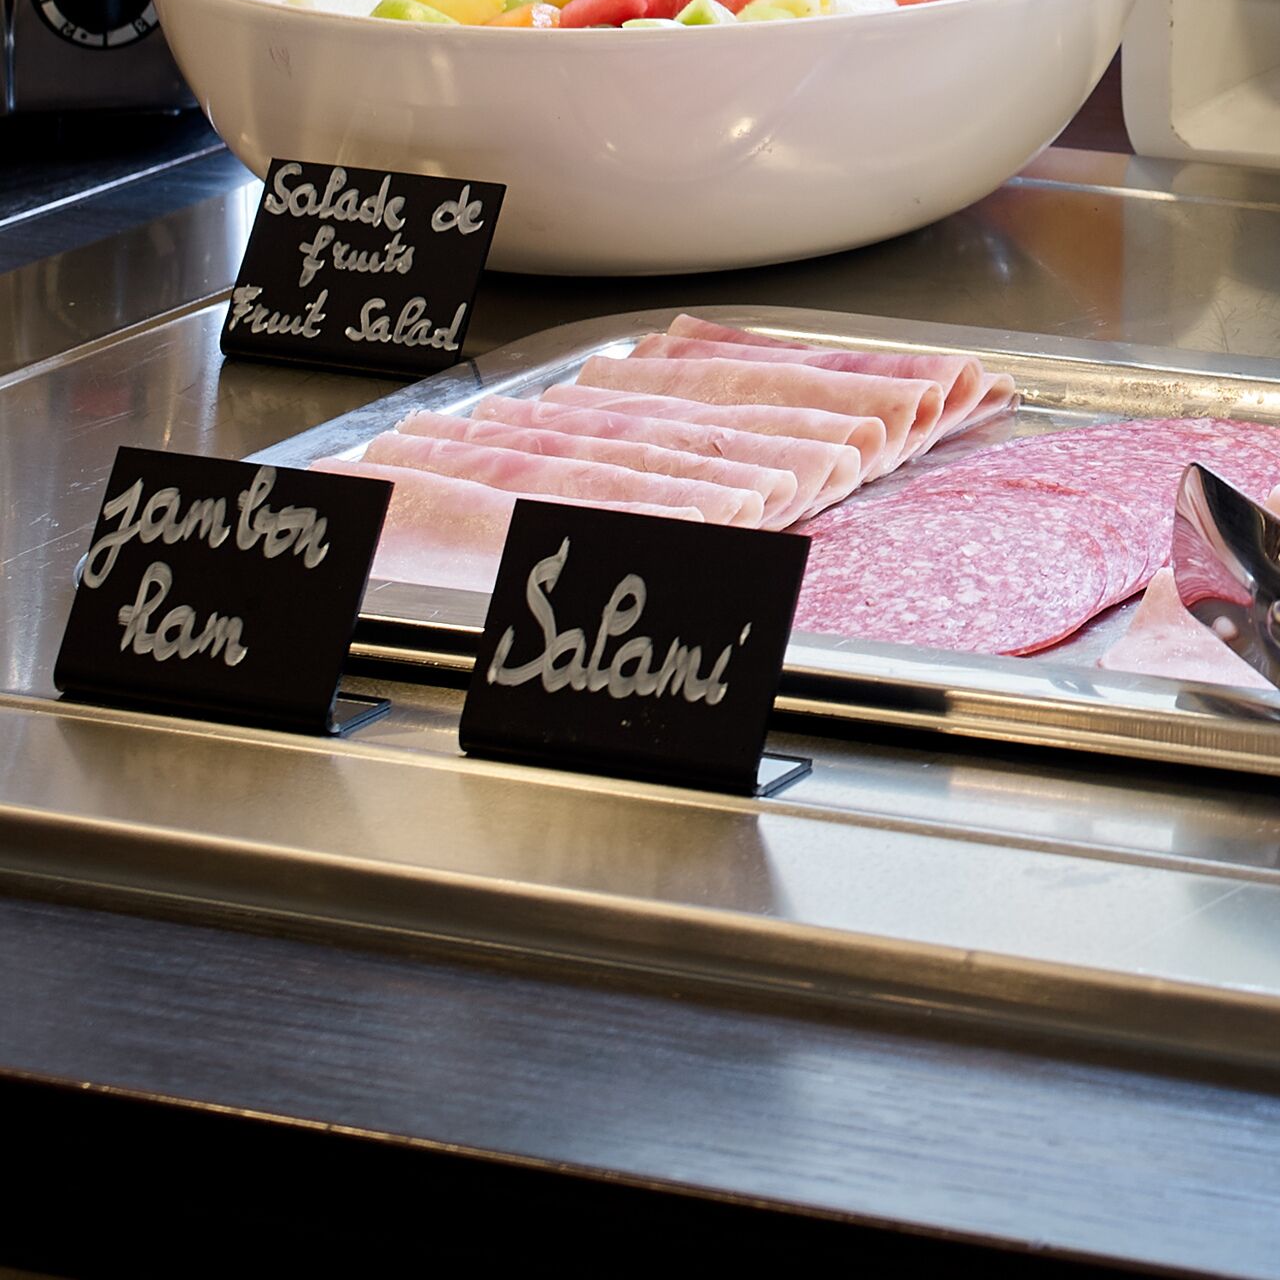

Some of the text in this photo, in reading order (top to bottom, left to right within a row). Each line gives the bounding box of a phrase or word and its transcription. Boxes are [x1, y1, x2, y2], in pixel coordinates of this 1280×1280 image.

[264, 162, 484, 235] Salade de
[345, 296, 467, 351] Salad
[118, 561, 248, 666] ham
[487, 536, 752, 706] Salami
